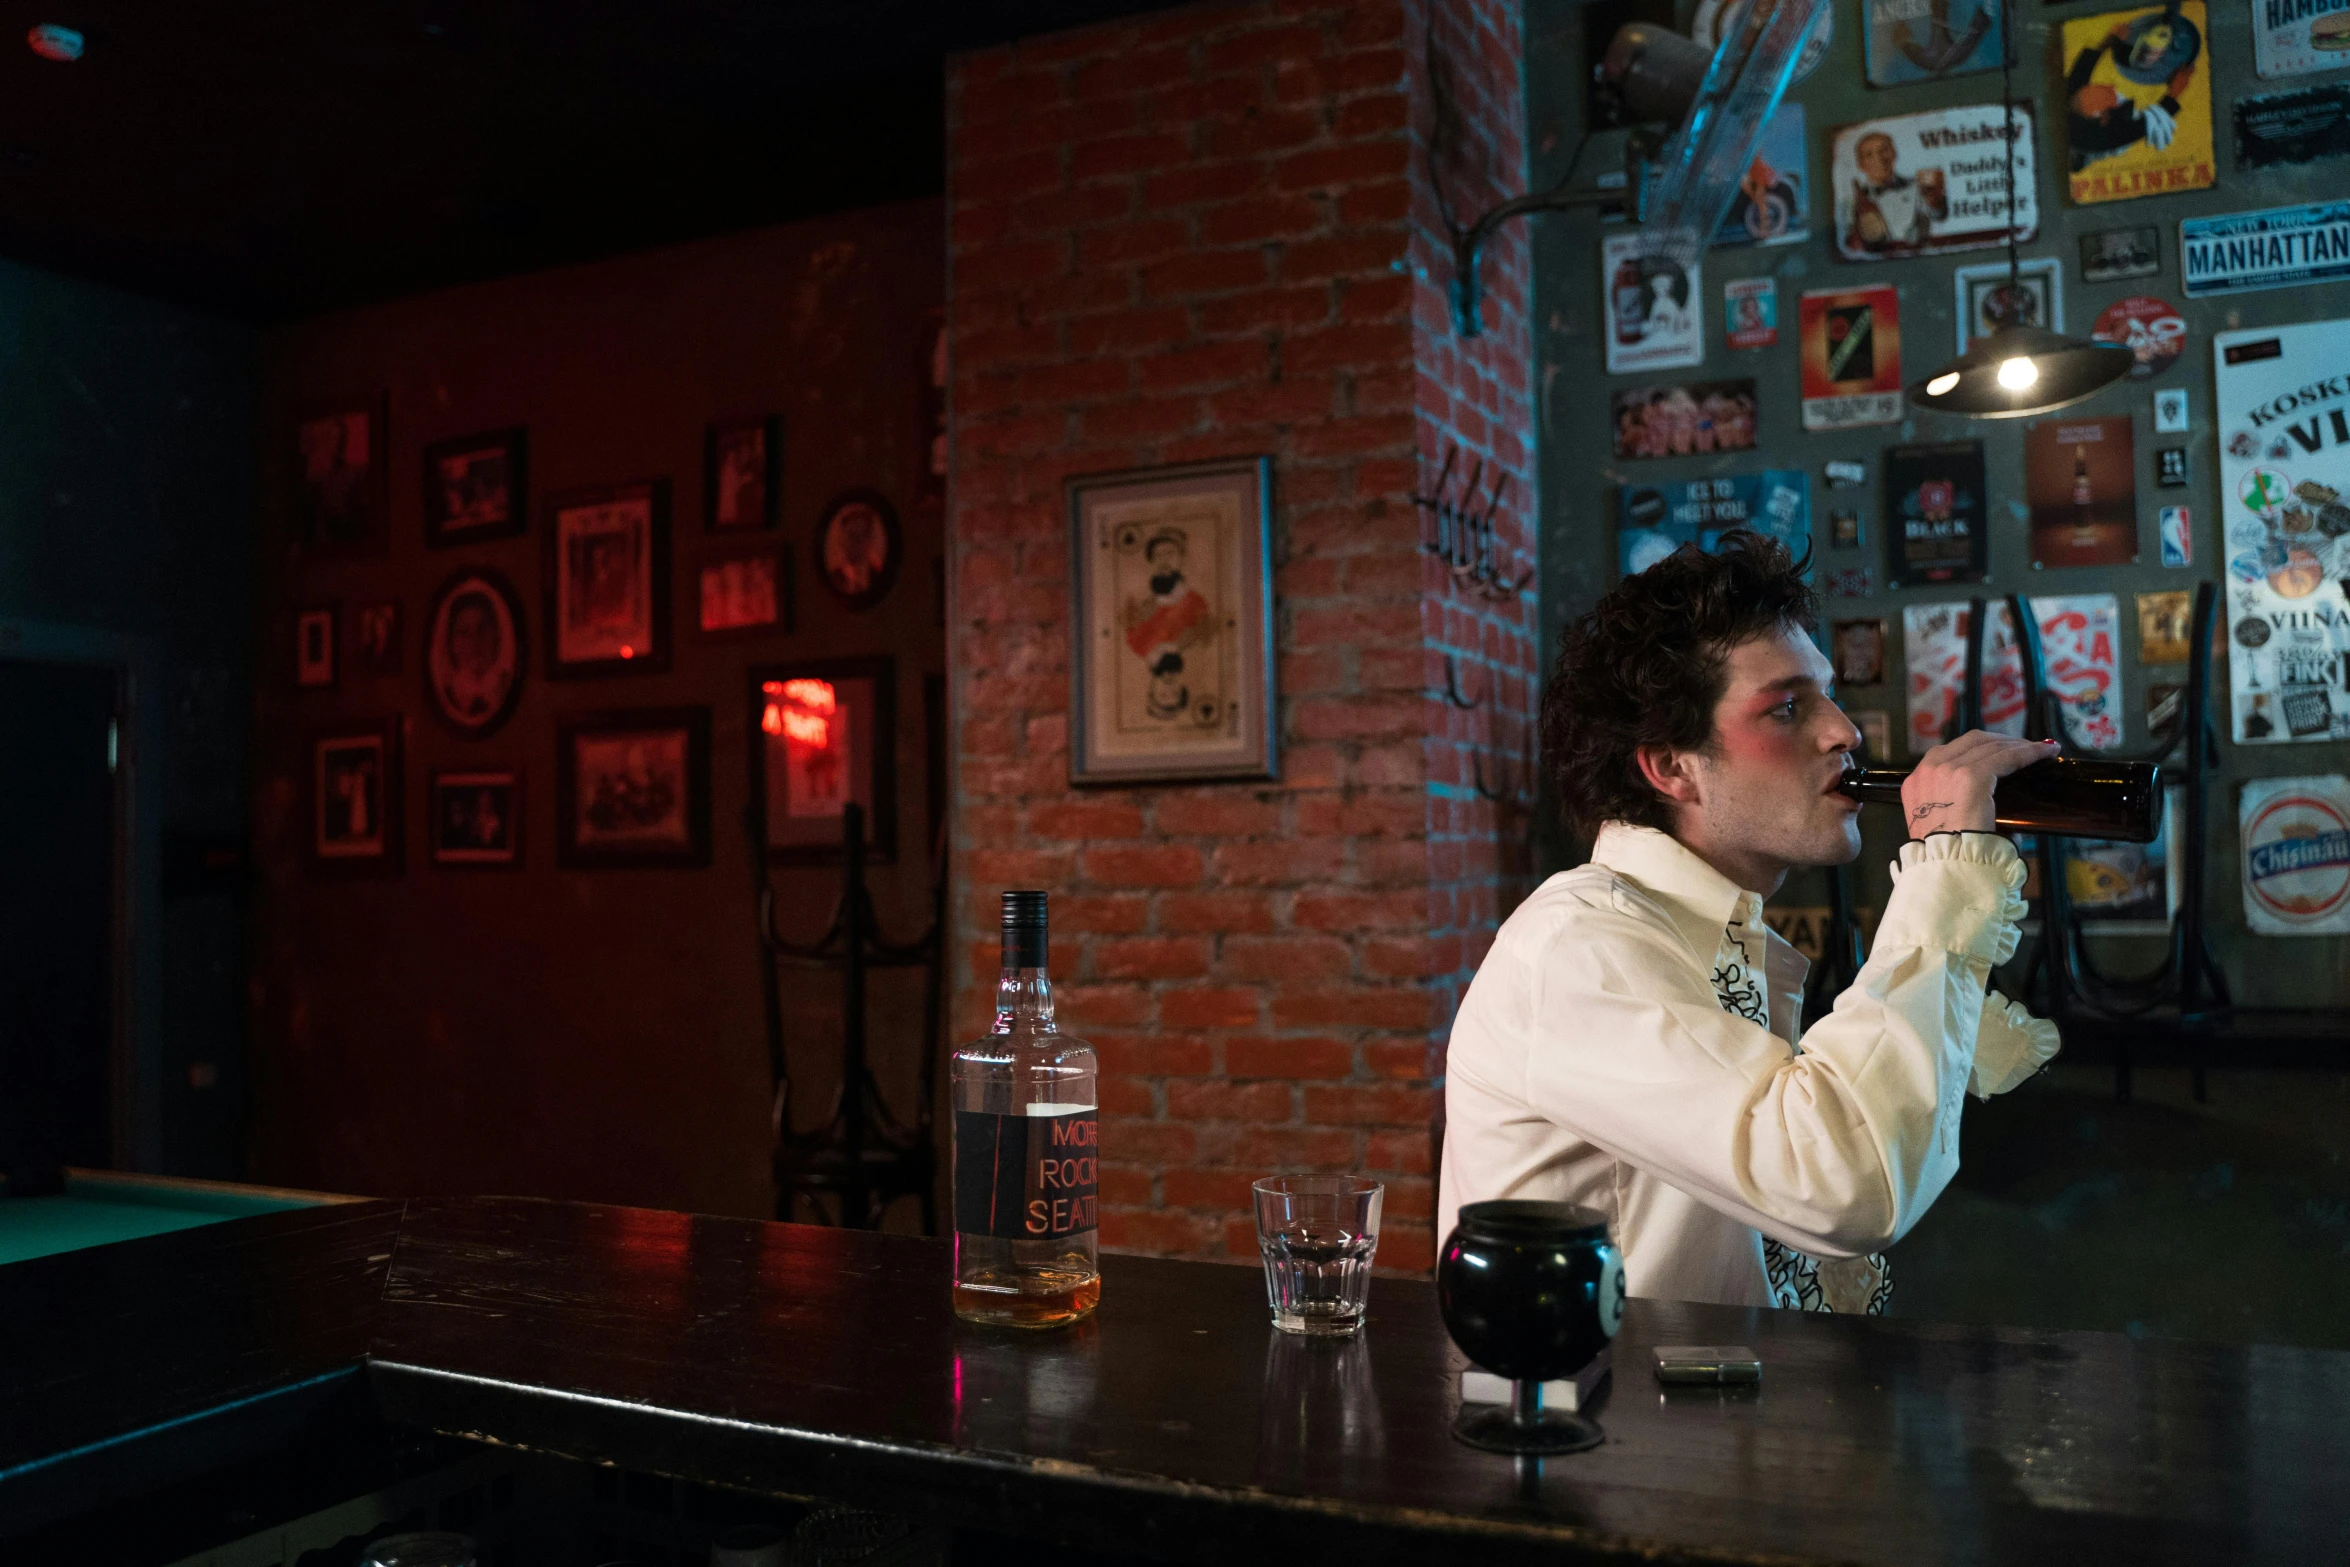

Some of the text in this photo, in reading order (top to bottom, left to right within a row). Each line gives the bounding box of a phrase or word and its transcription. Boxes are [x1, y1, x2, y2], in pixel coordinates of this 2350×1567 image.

[1950, 156, 2026, 176] Daddys
[2188, 226, 2349, 274] MANHATTAN
[2247, 374, 2350, 427] KOSK
